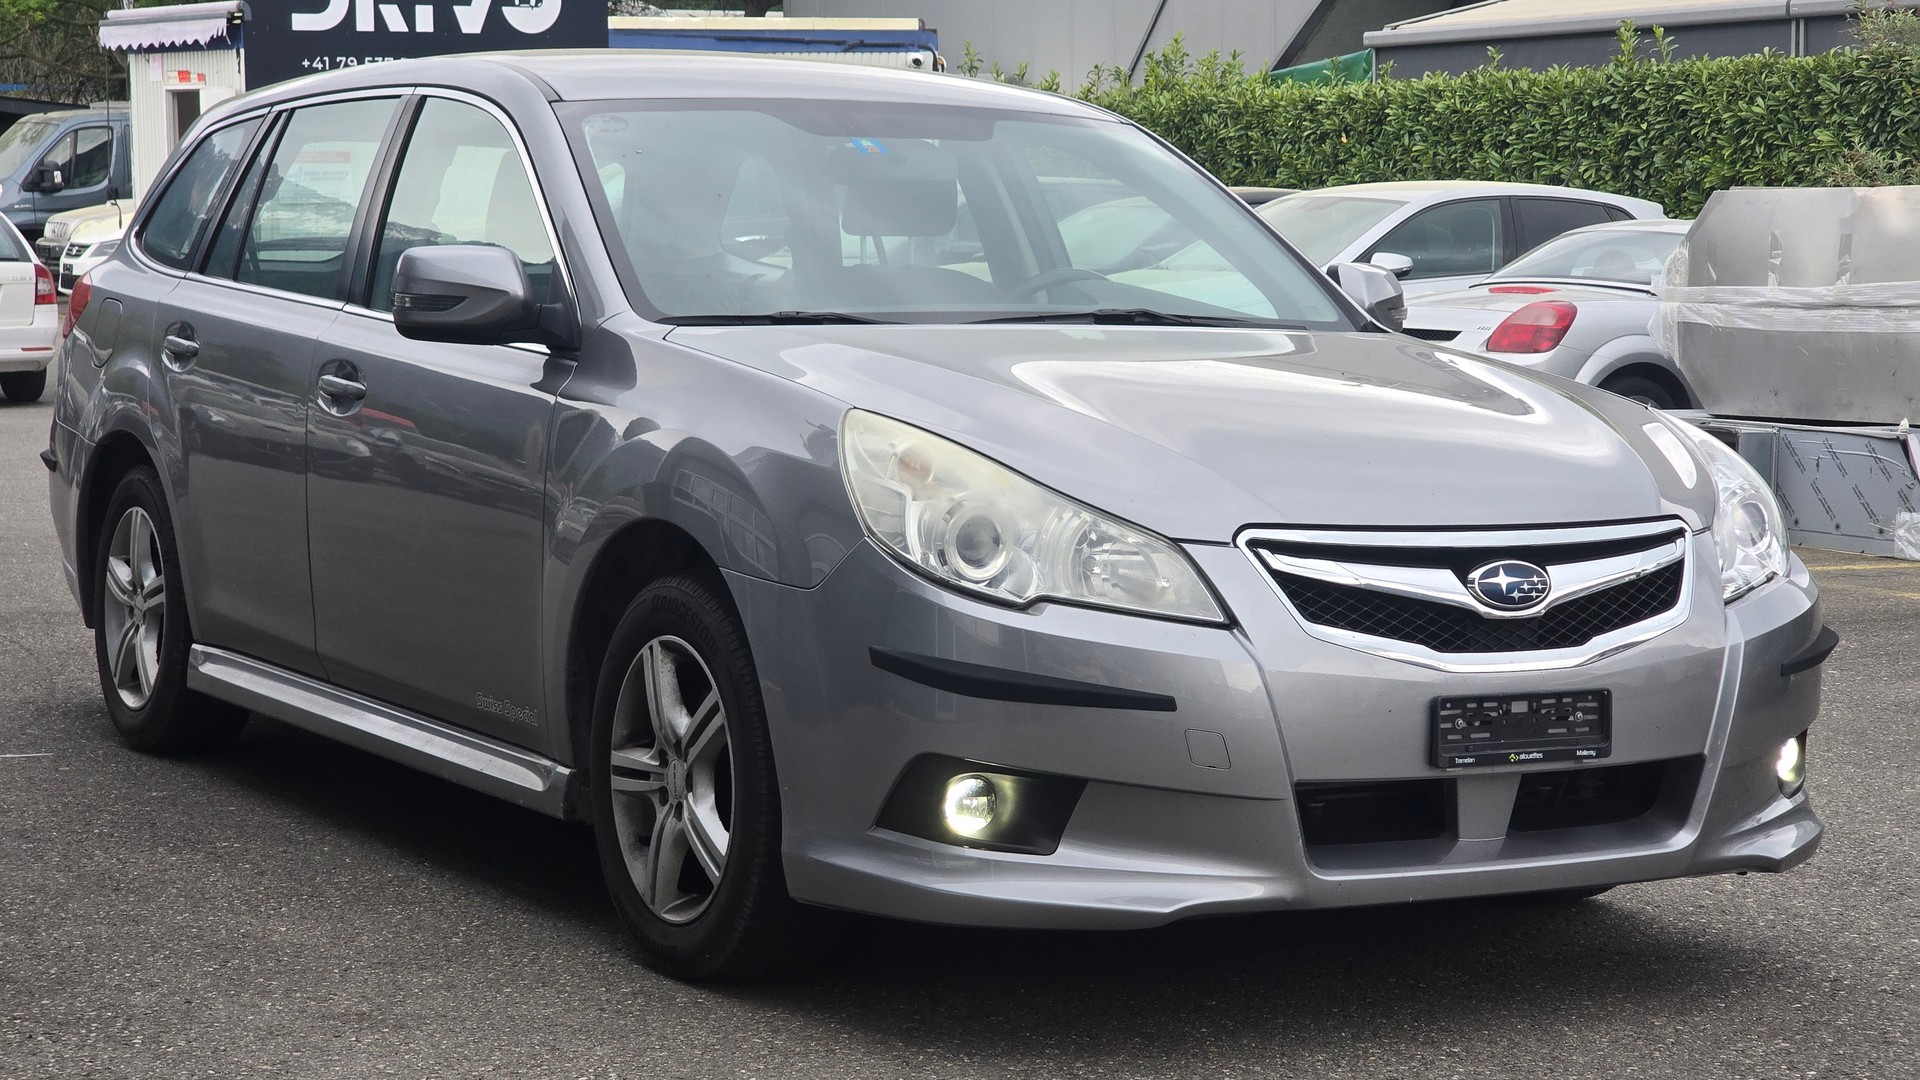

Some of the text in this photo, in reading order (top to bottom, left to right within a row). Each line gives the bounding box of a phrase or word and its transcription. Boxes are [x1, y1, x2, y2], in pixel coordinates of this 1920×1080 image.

[301, 56, 329, 70] +41
[336, 56, 358, 69] 79
[476, 692, 538, 727] Swiss Special
